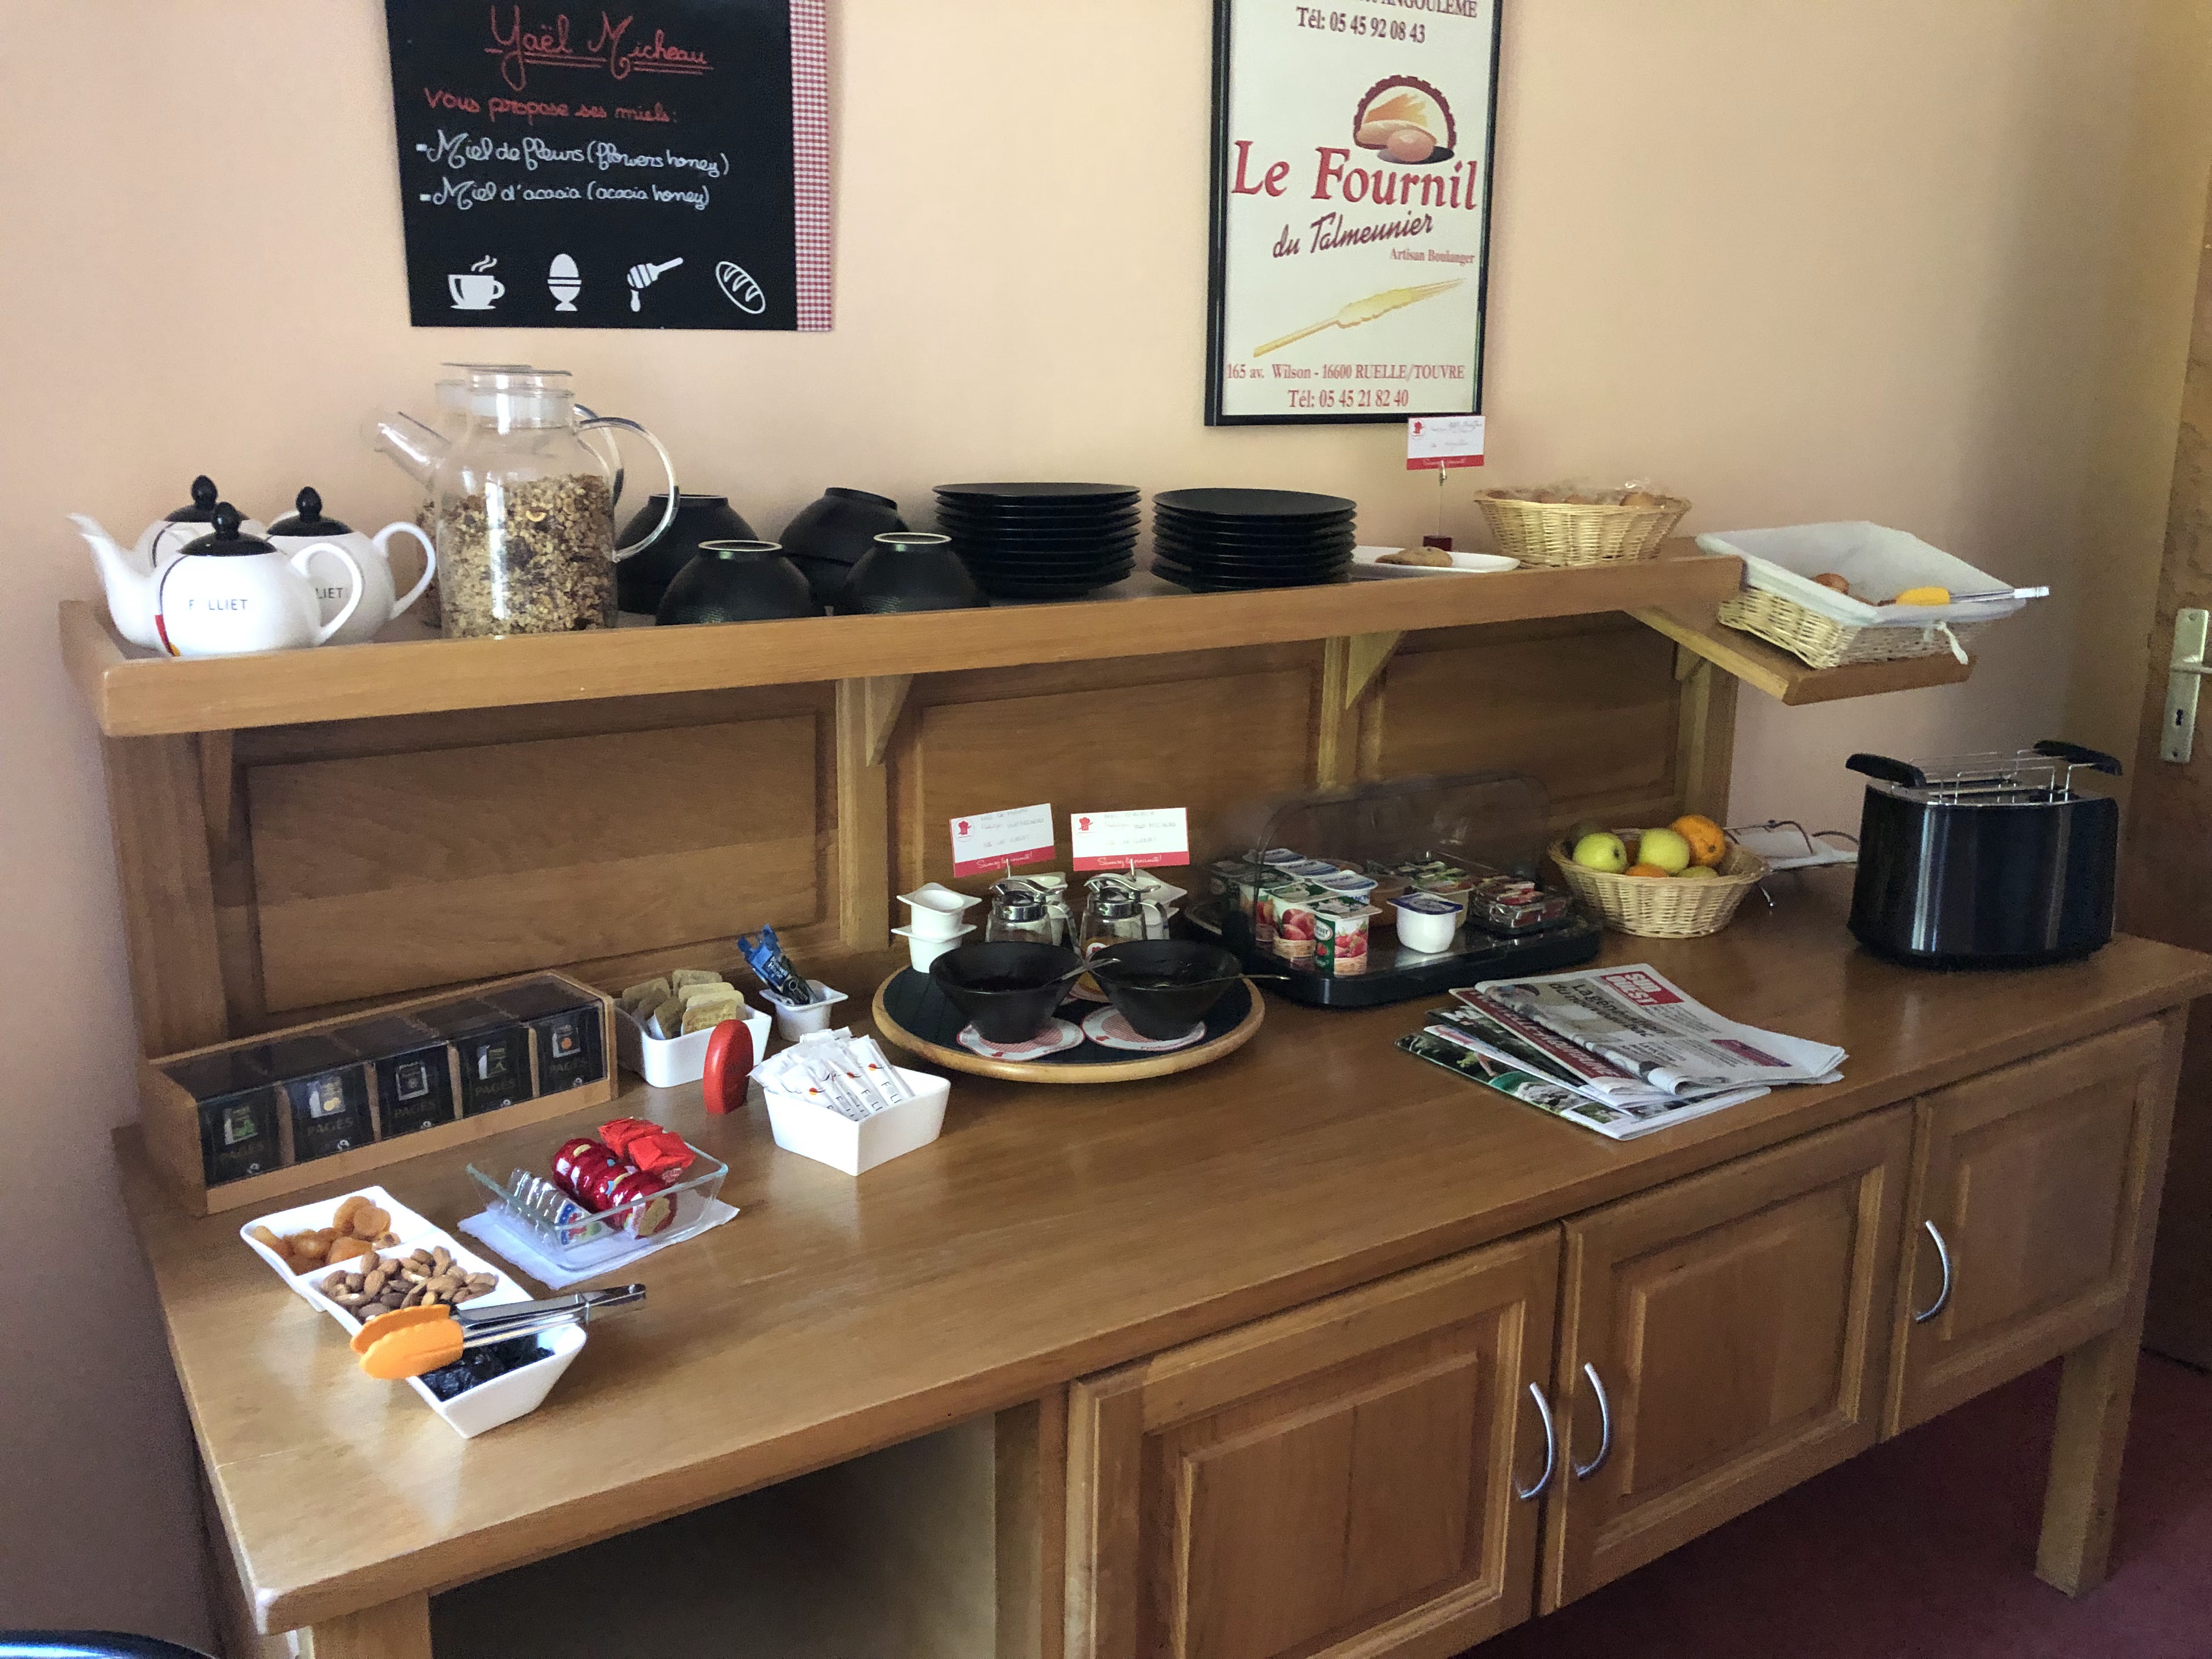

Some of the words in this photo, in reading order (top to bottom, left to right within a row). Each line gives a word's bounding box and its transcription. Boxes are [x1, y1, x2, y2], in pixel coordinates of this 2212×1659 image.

[1296, 7, 1326, 30] Tél:
[1330, 12, 1346, 32] 05
[1350, 15, 1367, 35] 45
[1370, 17, 1386, 38] 92
[1390, 20, 1406, 41] 08
[1409, 23, 1425, 43] 43
[485, 5, 573, 91] Yaël
[588, 12, 709, 79] Micheau
[489, 96, 568, 125] propose
[575, 99, 608, 117] ses
[496, 140, 520, 159] de
[521, 137, 584, 170] fleurs
[1231, 140, 1290, 197] Le
[1311, 146, 1477, 210] Fournil
[1272, 224, 1300, 258] du
[1310, 210, 1434, 253] Talmeunier
[1390, 248, 1425, 262] Artisan
[1427, 250, 1475, 266] Boulanger
[1227, 363, 1246, 379] 165
[1249, 367, 1265, 379] av.
[1271, 363, 1311, 379] Wilson
[1323, 364, 1352, 379] 16600
[1288, 390, 1315, 408] Tél:
[1319, 390, 1334, 407] 05
[1338, 390, 1354, 407] 45
[1358, 390, 1372, 407] 21
[1375, 390, 1391, 407] 82
[1394, 390, 1409, 407] 40
[189, 599, 248, 611] FLLIET
[768, 962, 783, 979] House
[770, 956, 788, 977] Maxwell
[1605, 975, 1658, 1005] OUEST
[1626, 973, 1662, 992] SUD
